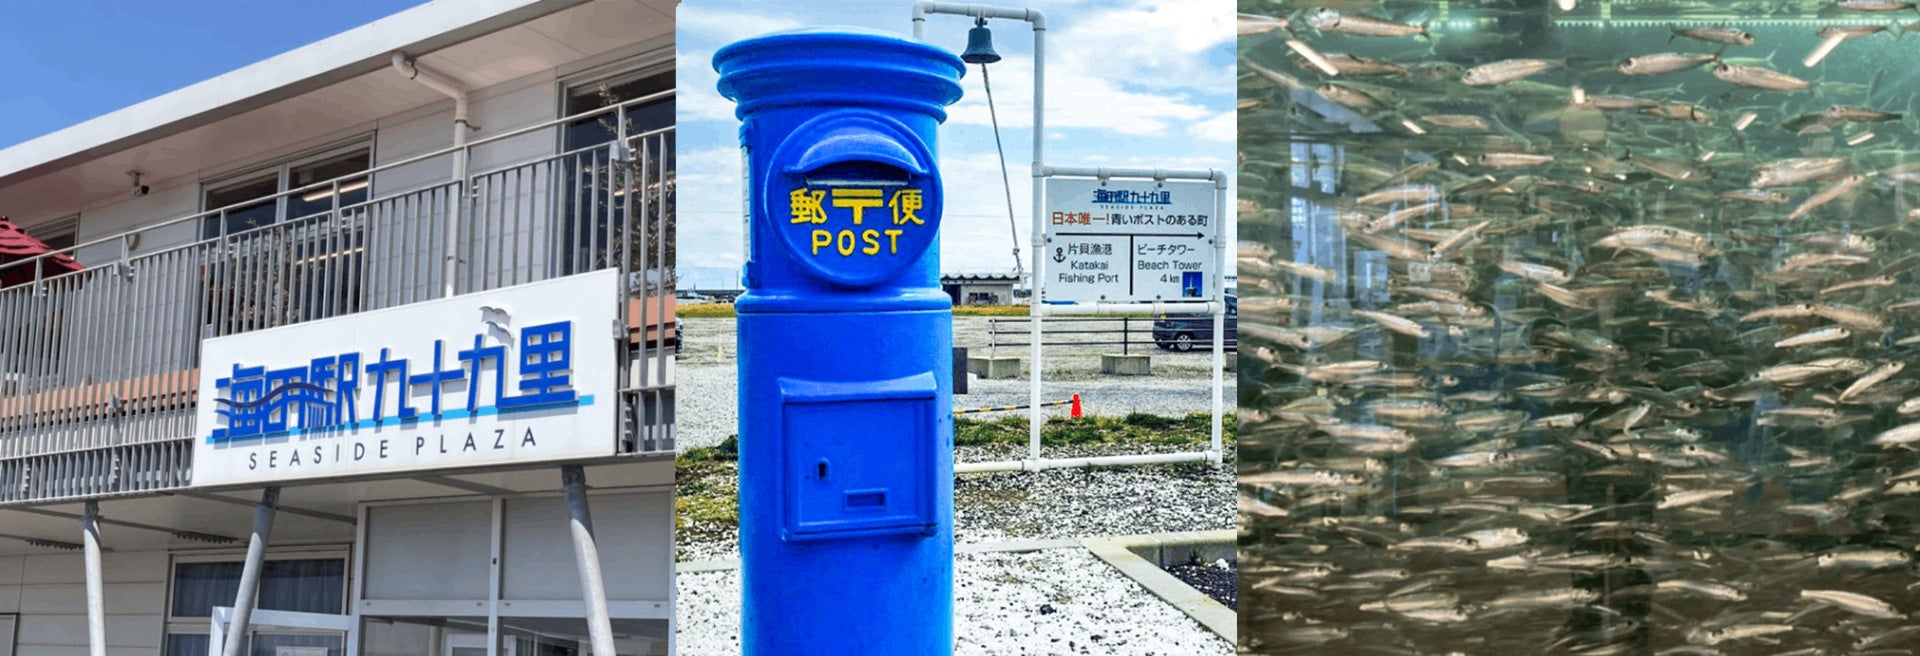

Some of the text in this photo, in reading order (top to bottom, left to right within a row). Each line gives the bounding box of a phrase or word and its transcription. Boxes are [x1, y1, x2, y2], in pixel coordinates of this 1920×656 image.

[812, 229, 903, 256] POST
[1067, 243, 1112, 256] 片貝漁港
[1137, 243, 1195, 256] ビーチタワー
[1070, 260, 1109, 270] Katakai
[1137, 260, 1203, 270] Beach Tower
[1059, 273, 1119, 284] Fishing Port
[248, 426, 537, 471] SEASIDE PLAZA
